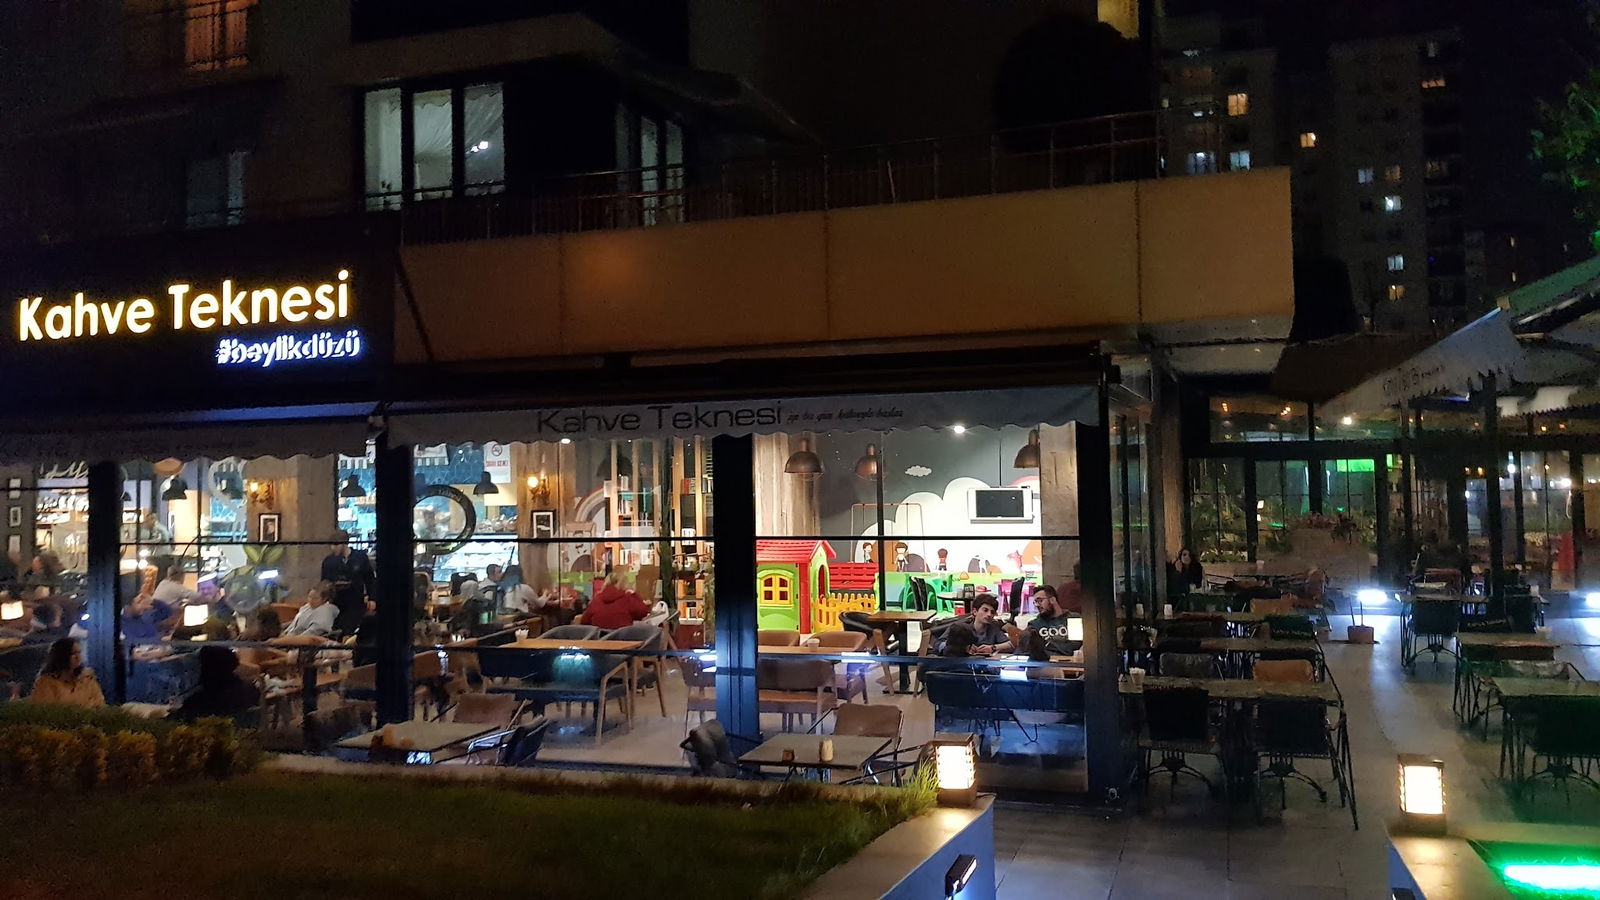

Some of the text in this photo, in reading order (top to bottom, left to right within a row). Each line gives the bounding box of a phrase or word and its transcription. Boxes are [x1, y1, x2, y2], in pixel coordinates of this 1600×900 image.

[18, 269, 350, 342] Kahve Teknesi
[537, 407, 641, 434] Kahve
[648, 400, 782, 430] Teknesi
[1039, 626, 1068, 637] GOO
